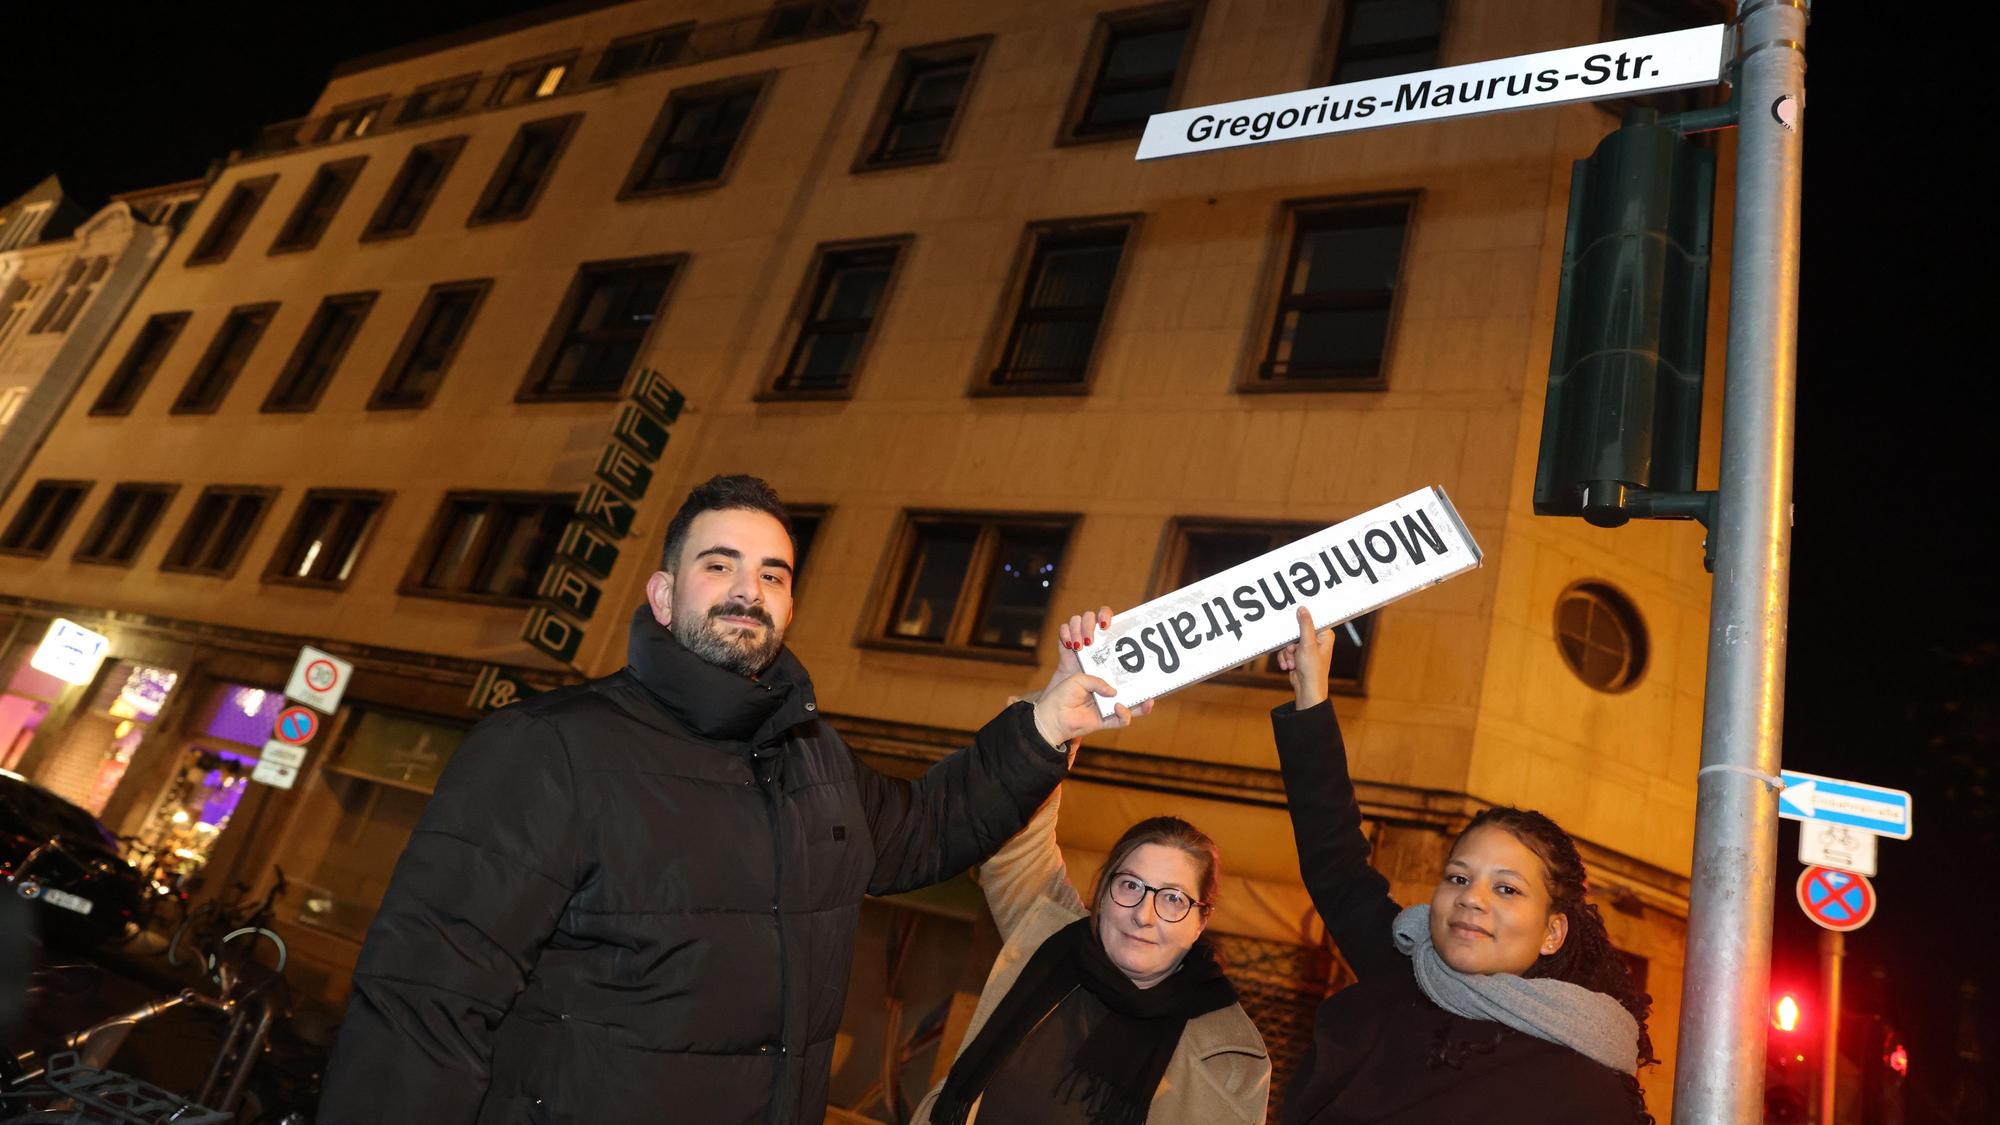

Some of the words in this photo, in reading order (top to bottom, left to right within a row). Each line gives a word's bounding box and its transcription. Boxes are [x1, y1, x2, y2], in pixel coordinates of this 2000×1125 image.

[1186, 53, 1661, 143] Gregorius-Maurus-Str.
[540, 371, 673, 652] ELEKTRO
[1115, 508, 1449, 674] Mohrenstraße
